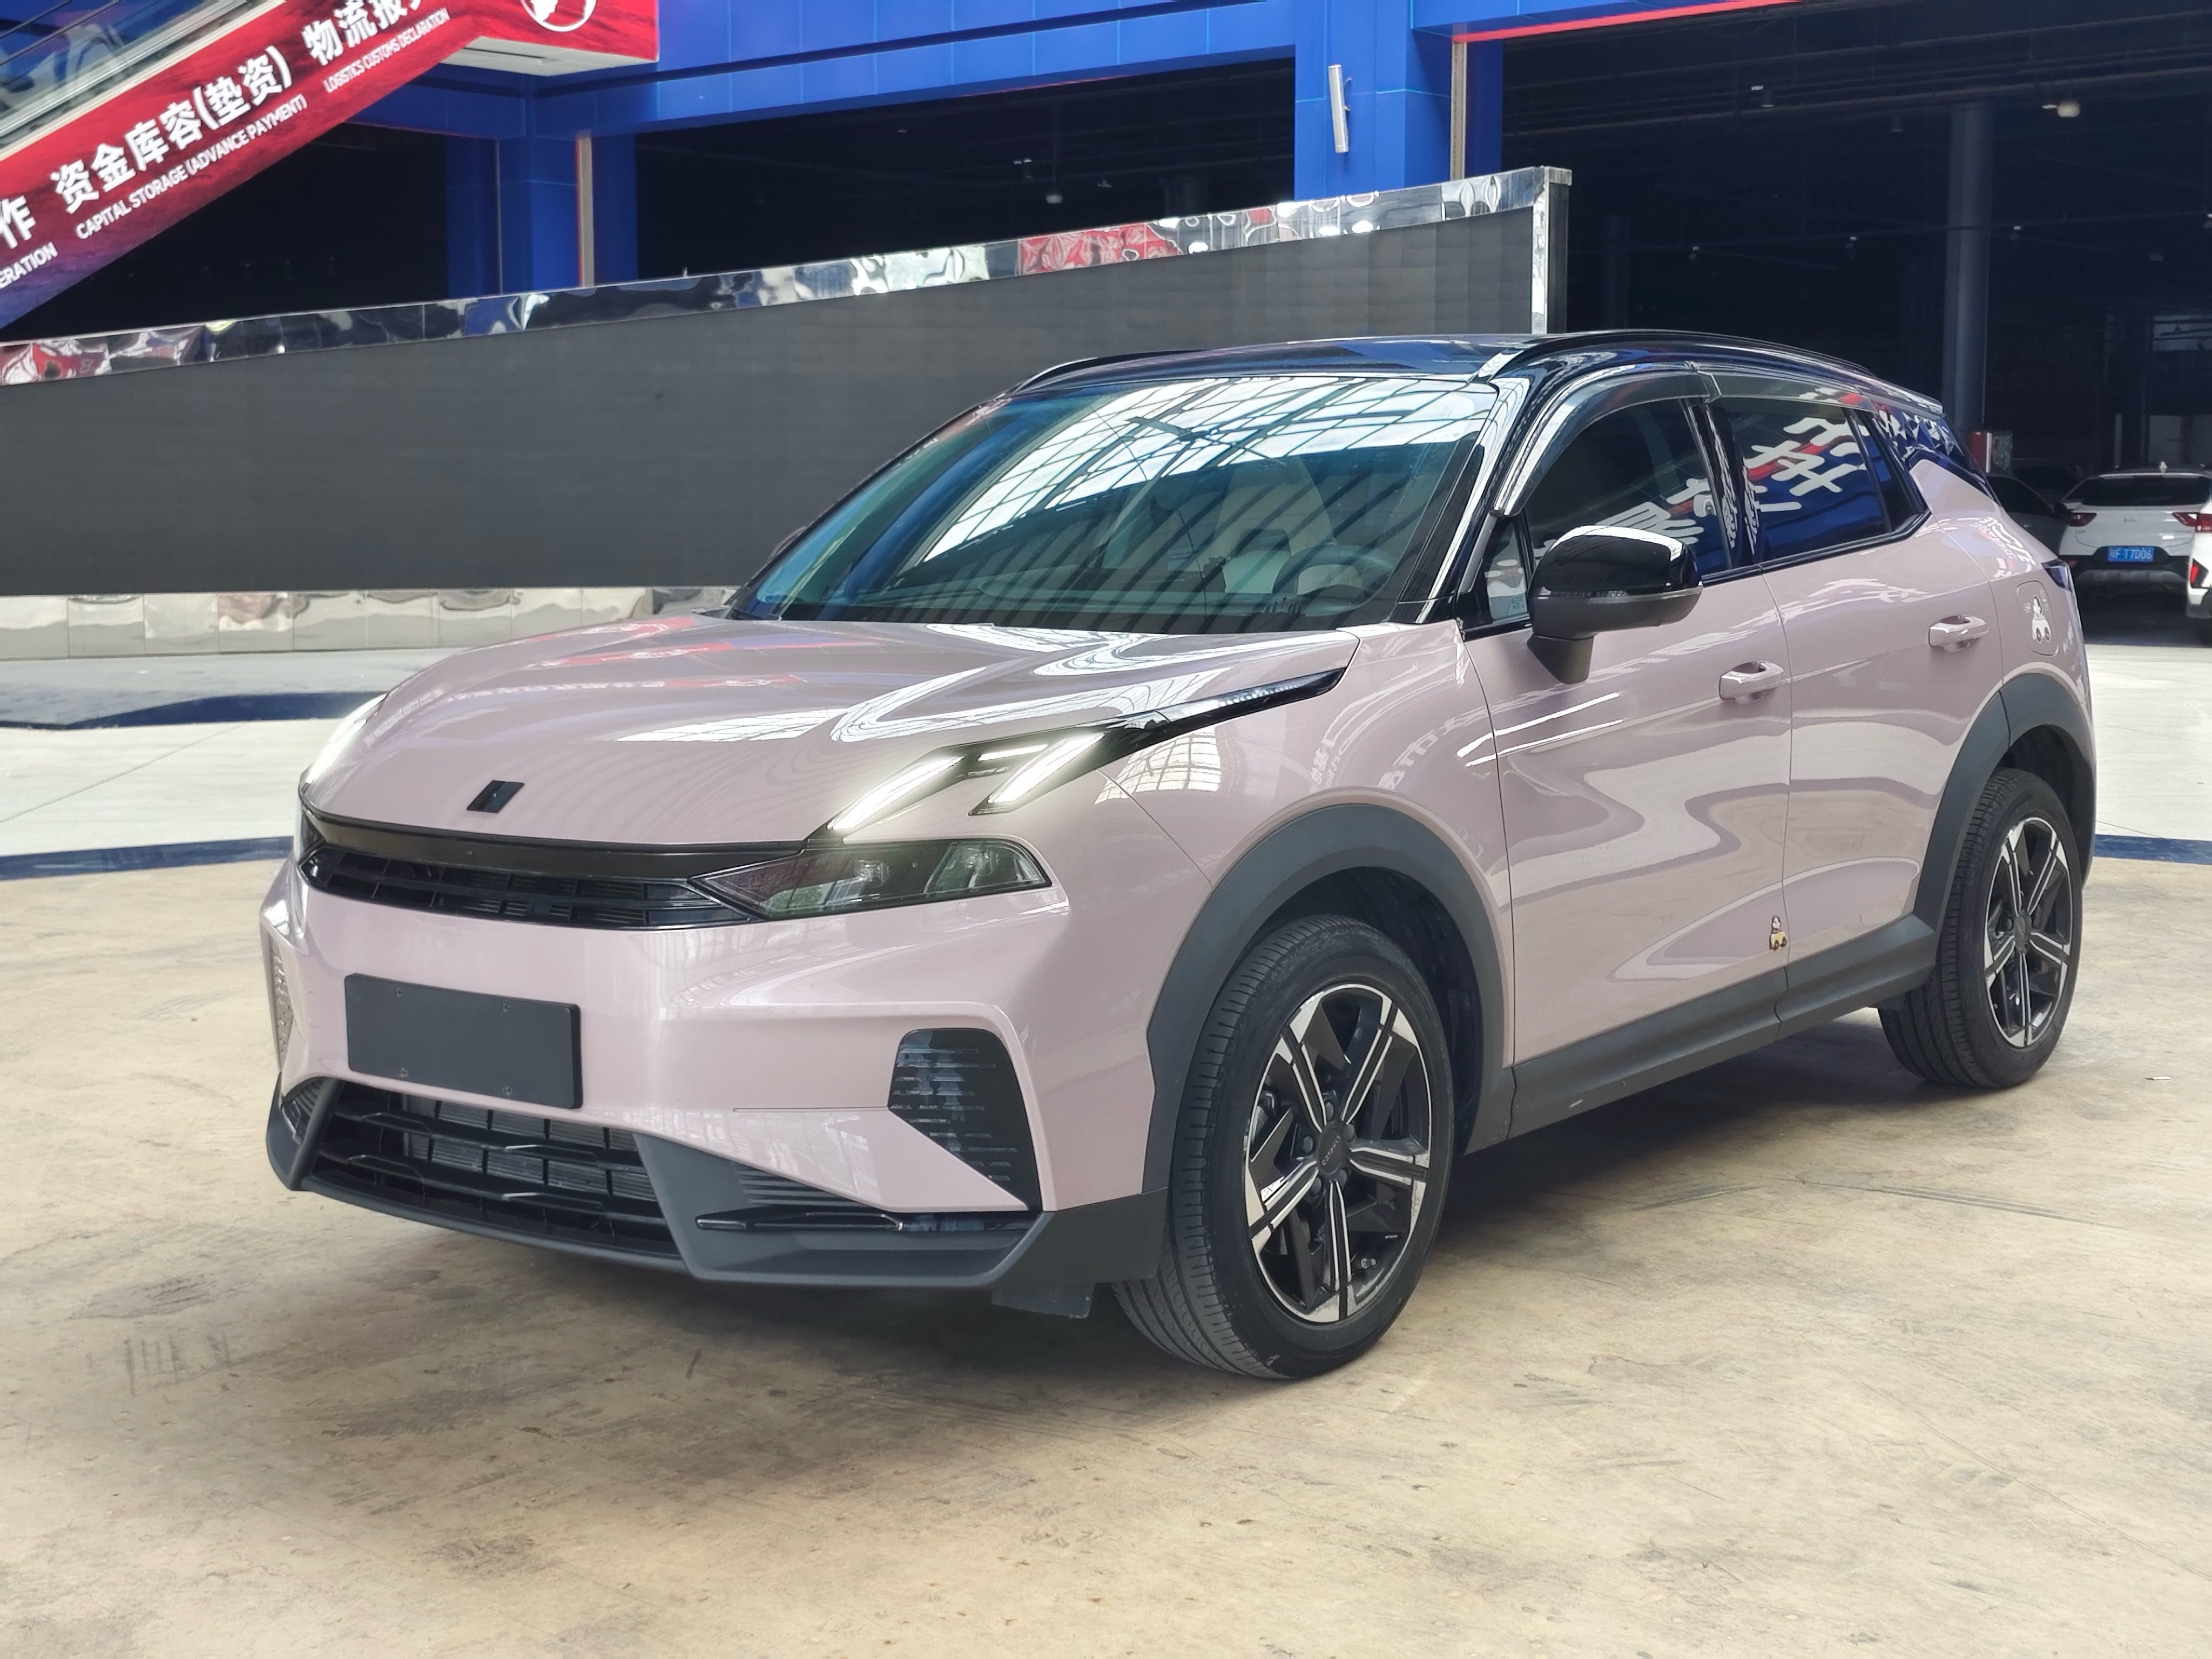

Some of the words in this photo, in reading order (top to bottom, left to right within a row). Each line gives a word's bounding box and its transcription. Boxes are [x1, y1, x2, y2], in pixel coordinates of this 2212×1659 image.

[302, 0, 421, 66] 物流报
[323, 59, 365, 93] LOGISTICS
[362, 38, 401, 69] CUSTOMS
[397, 7, 450, 48] DECLARATION
[50, 45, 292, 213] 资金库容(垫资)
[76, 199, 132, 239] CAPITAL
[128, 164, 188, 208] STORAGE
[185, 129, 249, 176] (ADVANCE
[245, 93, 307, 139] PAYMENT)
